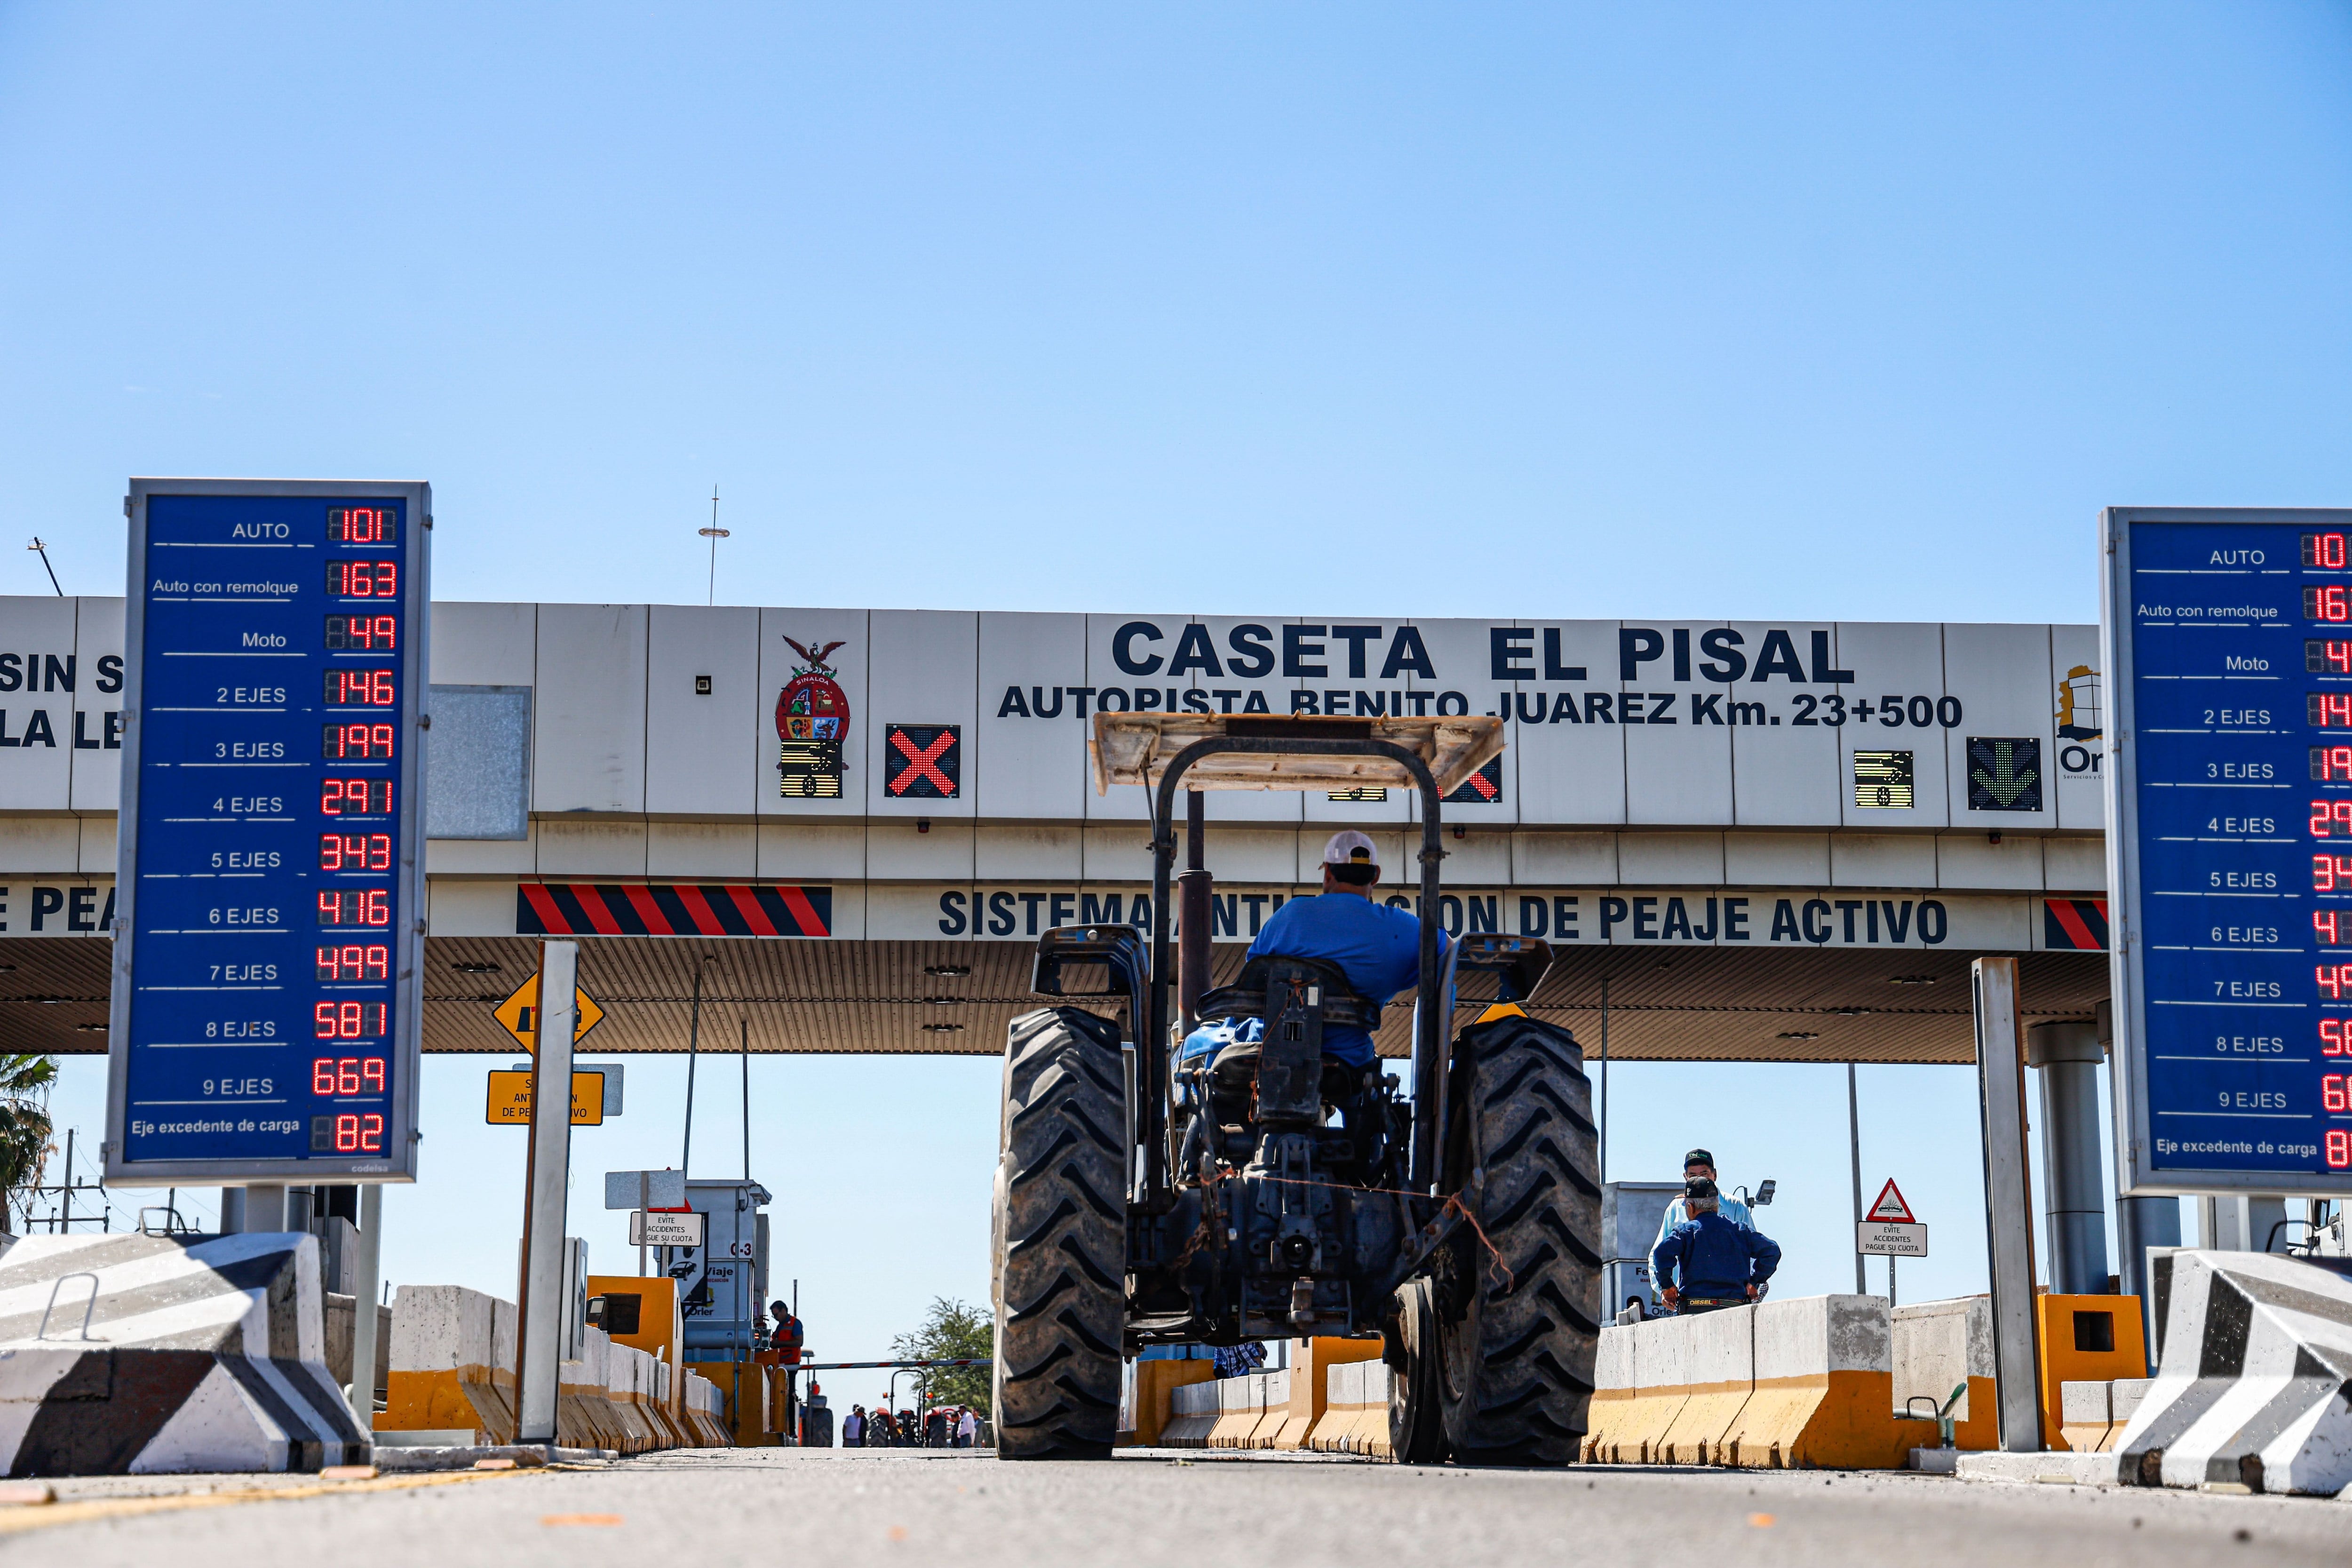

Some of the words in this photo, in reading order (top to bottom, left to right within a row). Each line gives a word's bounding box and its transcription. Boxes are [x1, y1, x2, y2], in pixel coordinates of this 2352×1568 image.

[233, 524, 288, 538] AUTO
[343, 508, 382, 542] 101
[2210, 550, 2264, 564] AUTO
[2314, 533, 2345, 568] 10
[153, 580, 188, 591] Auto
[194, 583, 220, 592] con
[227, 581, 298, 595] remolque
[342, 562, 396, 597] 163
[2138, 605, 2171, 616] Auto
[2209, 605, 2277, 619] remolque
[2316, 586, 2352, 621] 16
[243, 633, 286, 646] Moto
[350, 616, 395, 648] 49
[1112, 621, 1437, 679] CASETA
[1491, 627, 1587, 680] EL
[1619, 628, 1854, 684] PISAL
[2227, 656, 2268, 670] Moto
[96, 655, 123, 693] S
[796, 677, 828, 685] SINALOA
[218, 688, 227, 702] 2
[235, 688, 285, 702] EJES
[340, 670, 394, 705] 146
[997, 686, 1271, 718] AUTOPISTA
[1290, 690, 1469, 717] BENITO
[1486, 692, 1677, 725] JUAREZ
[1792, 694, 1962, 728] 23+500
[2320, 695, 2352, 726] 14
[2205, 710, 2214, 724] 2
[2222, 710, 2270, 724] EJES
[74, 711, 122, 749] LE
[339, 724, 393, 757] 199
[216, 743, 225, 757] 3
[234, 743, 283, 757] EJES
[2060, 746, 2104, 772] Or
[2322, 747, 2352, 780] 19
[2209, 764, 2217, 777] 3
[2225, 764, 2273, 778] EJES
[214, 798, 223, 811] 4
[232, 798, 281, 812] EJES
[322, 780, 392, 815] 291
[2209, 818, 2218, 831] 4
[2226, 818, 2274, 833] EJES
[2310, 800, 2352, 837] 29
[212, 853, 222, 867] 5
[230, 852, 279, 867] EJES
[322, 834, 390, 870] 343
[2211, 873, 2220, 886] 5
[2228, 873, 2276, 887] EJES
[2313, 854, 2352, 891] 34
[210, 909, 219, 923] 6
[228, 908, 278, 923] EJES
[319, 890, 389, 925] 416
[939, 891, 1153, 936] SISTEMA
[1519, 895, 1579, 939] DE
[1600, 896, 1749, 941] PEAJE
[1770, 898, 1947, 944] ACTIVO
[2212, 927, 2221, 941] 6
[2229, 928, 2278, 942] EJES
[317, 945, 388, 979] 499
[211, 966, 219, 980] 7
[226, 965, 276, 980] EJES
[2215, 982, 2224, 995] 7
[2232, 982, 2280, 997] EJES
[315, 1002, 386, 1038] 581
[207, 1022, 216, 1037] 8
[224, 1022, 275, 1036] EJES
[2217, 1037, 2226, 1051] 8
[2234, 1037, 2283, 1052] EJES
[313, 1058, 385, 1095] 669
[204, 1080, 213, 1094] 9
[222, 1079, 272, 1094] EJES
[2220, 1093, 2229, 1106] 9
[2237, 1093, 2286, 1107] EJES
[502, 1107, 515, 1116] DE
[519, 1107, 530, 1116] PE
[133, 1121, 154, 1136] Eje
[159, 1121, 232, 1133] excedente
[238, 1120, 254, 1131] de
[260, 1121, 299, 1133] carga
[336, 1114, 383, 1151] 82
[2157, 1139, 2177, 1154] Eje
[2183, 1141, 2252, 1153] excedente
[2258, 1142, 2273, 1153] de
[2279, 1145, 2317, 1157] carga
